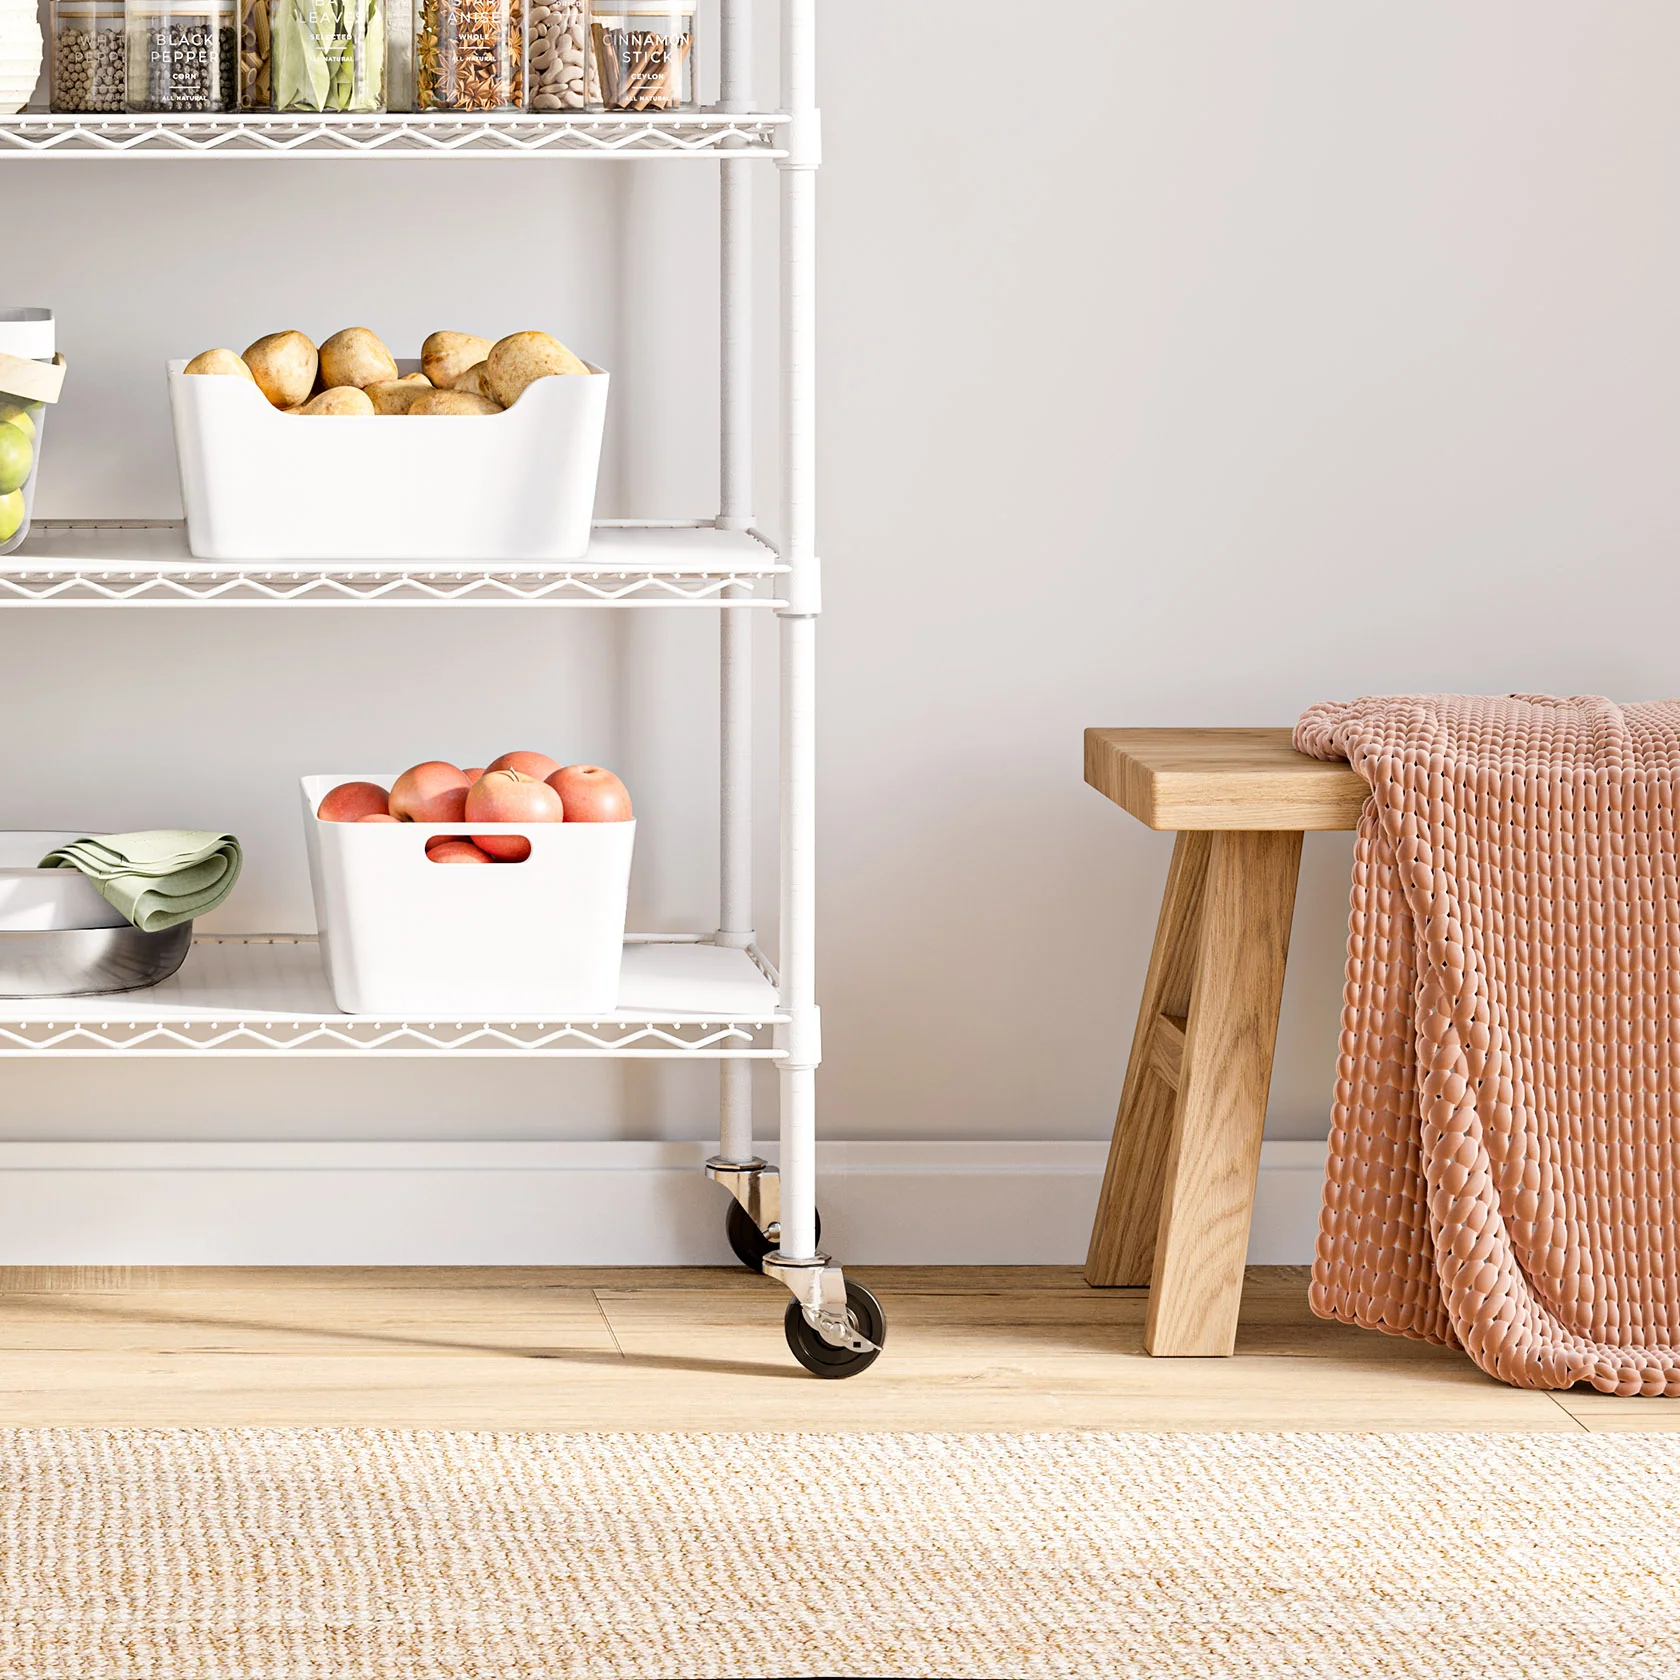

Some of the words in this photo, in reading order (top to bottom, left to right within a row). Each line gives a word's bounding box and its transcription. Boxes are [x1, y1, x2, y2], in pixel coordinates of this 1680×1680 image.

[299, 11, 361, 23] LEAVES
[448, 11, 501, 23] ANISE
[156, 34, 214, 46] BLACK
[602, 34, 690, 46] CINNAMON
[151, 51, 219, 63] PEPPER
[622, 51, 673, 63] STICK
